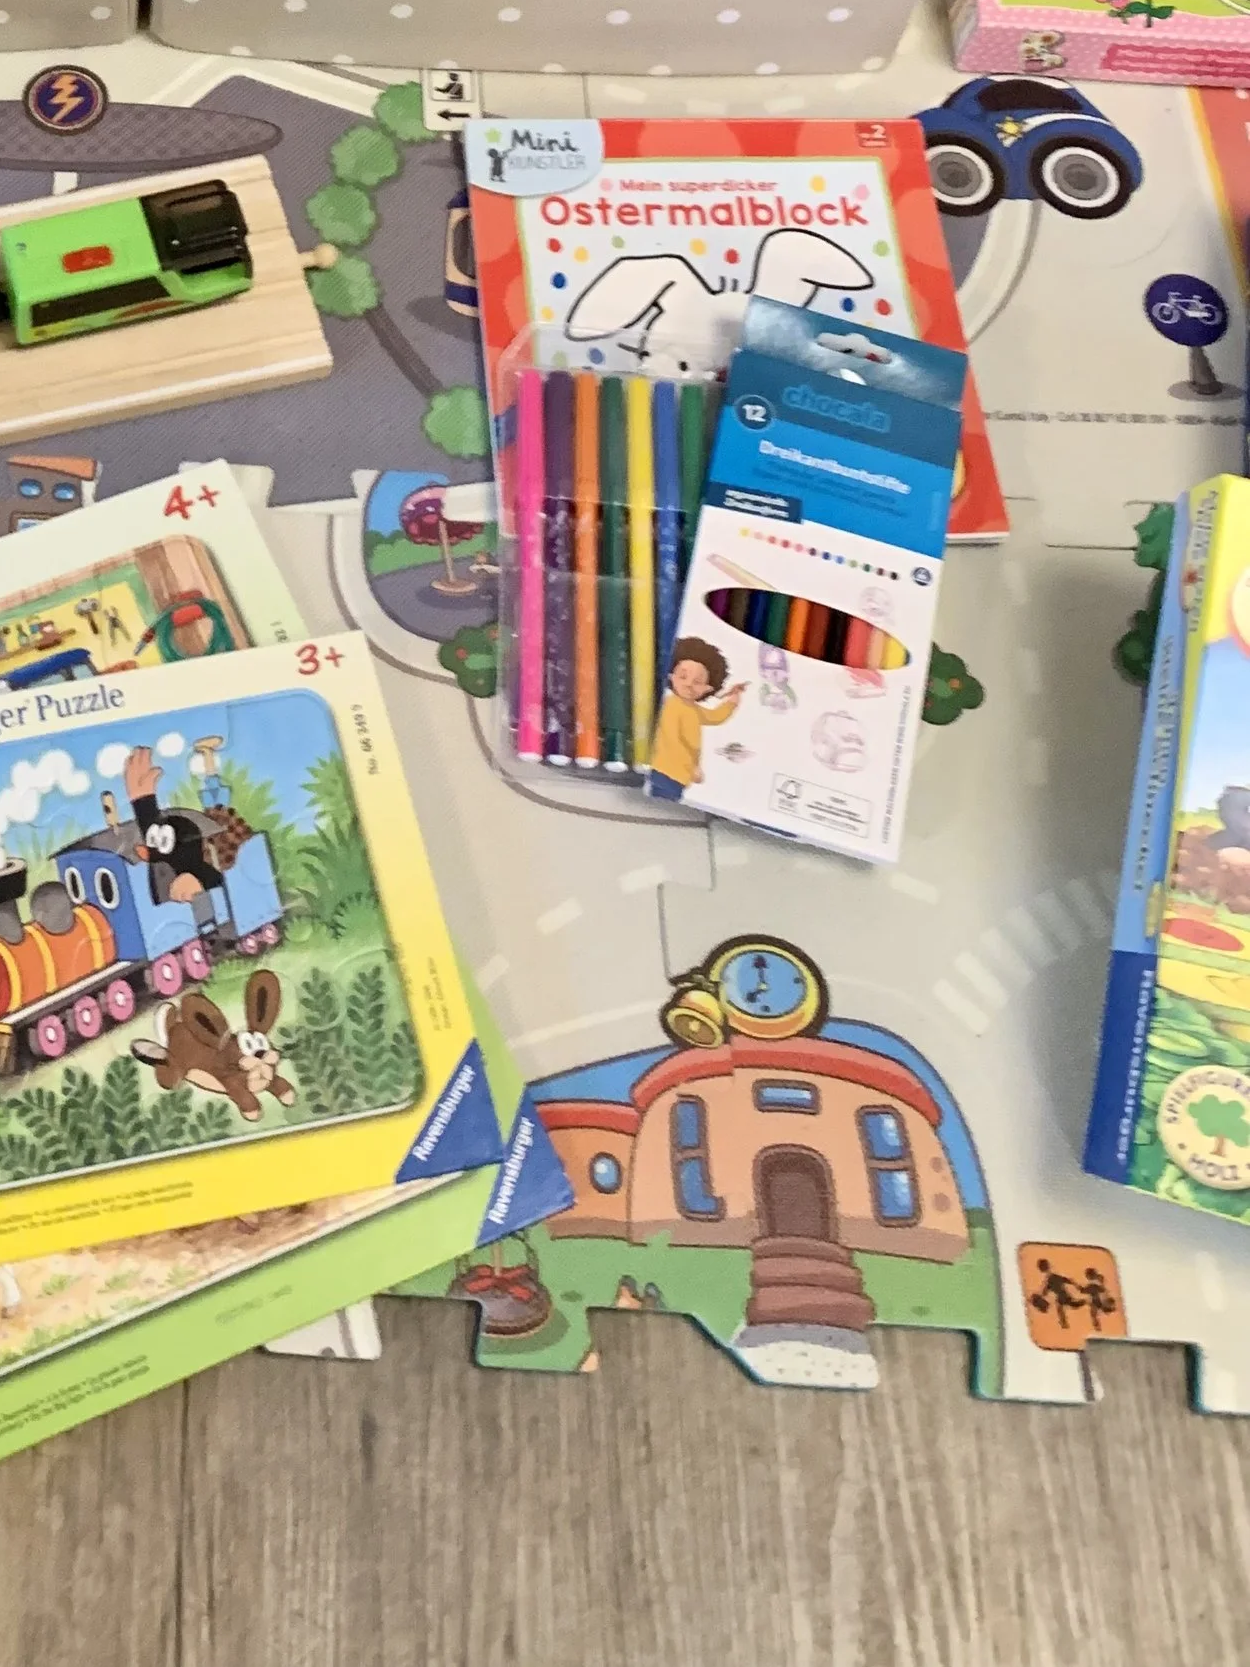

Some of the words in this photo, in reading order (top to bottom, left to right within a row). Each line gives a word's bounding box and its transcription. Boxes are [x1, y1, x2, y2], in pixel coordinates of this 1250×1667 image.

[511, 129, 579, 152] Mini
[619, 179, 664, 192] Mein
[668, 179, 779, 195] superdicker
[541, 196, 869, 227] Ostermalblock
[742, 404, 767, 422] 12
[164, 485, 220, 520] 4+
[295, 644, 345, 675] 3+
[34, 684, 126, 722] Puzzle
[412, 1064, 476, 1162] Ravensburger
[487, 1117, 536, 1225] Ravensburger
